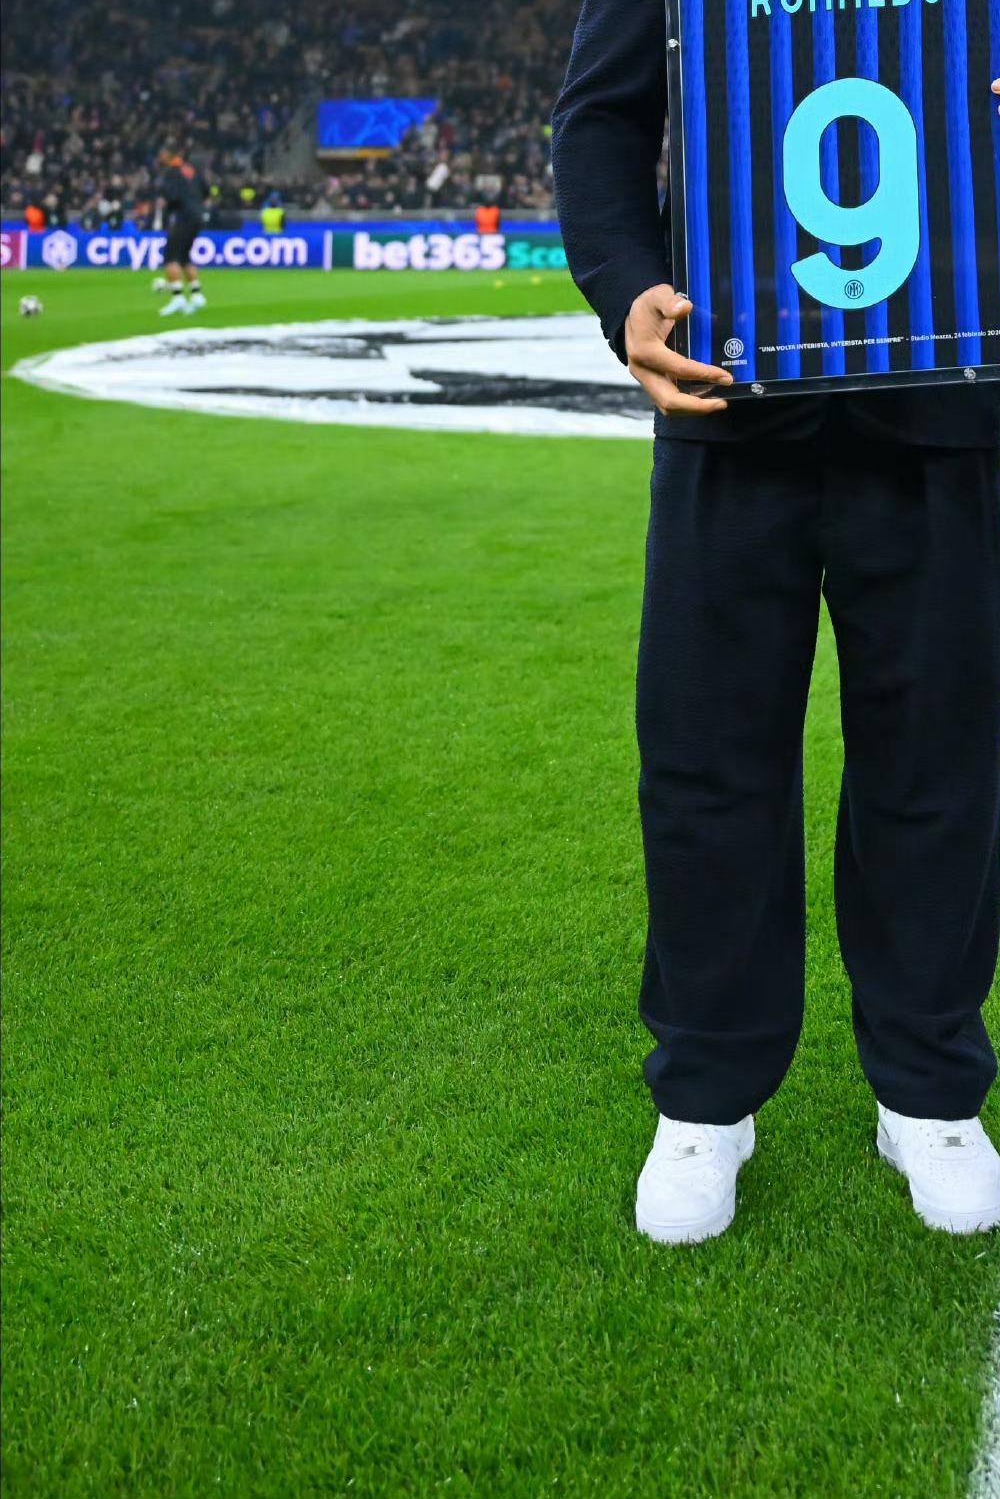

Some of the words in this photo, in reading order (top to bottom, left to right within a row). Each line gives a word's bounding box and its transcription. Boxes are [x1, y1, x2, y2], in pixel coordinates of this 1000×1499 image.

[782, 77, 920, 310] 9
[86, 235, 307, 271] crypo.com
[353, 231, 506, 270] bet365
[831, 339, 862, 347] INTERISTA
